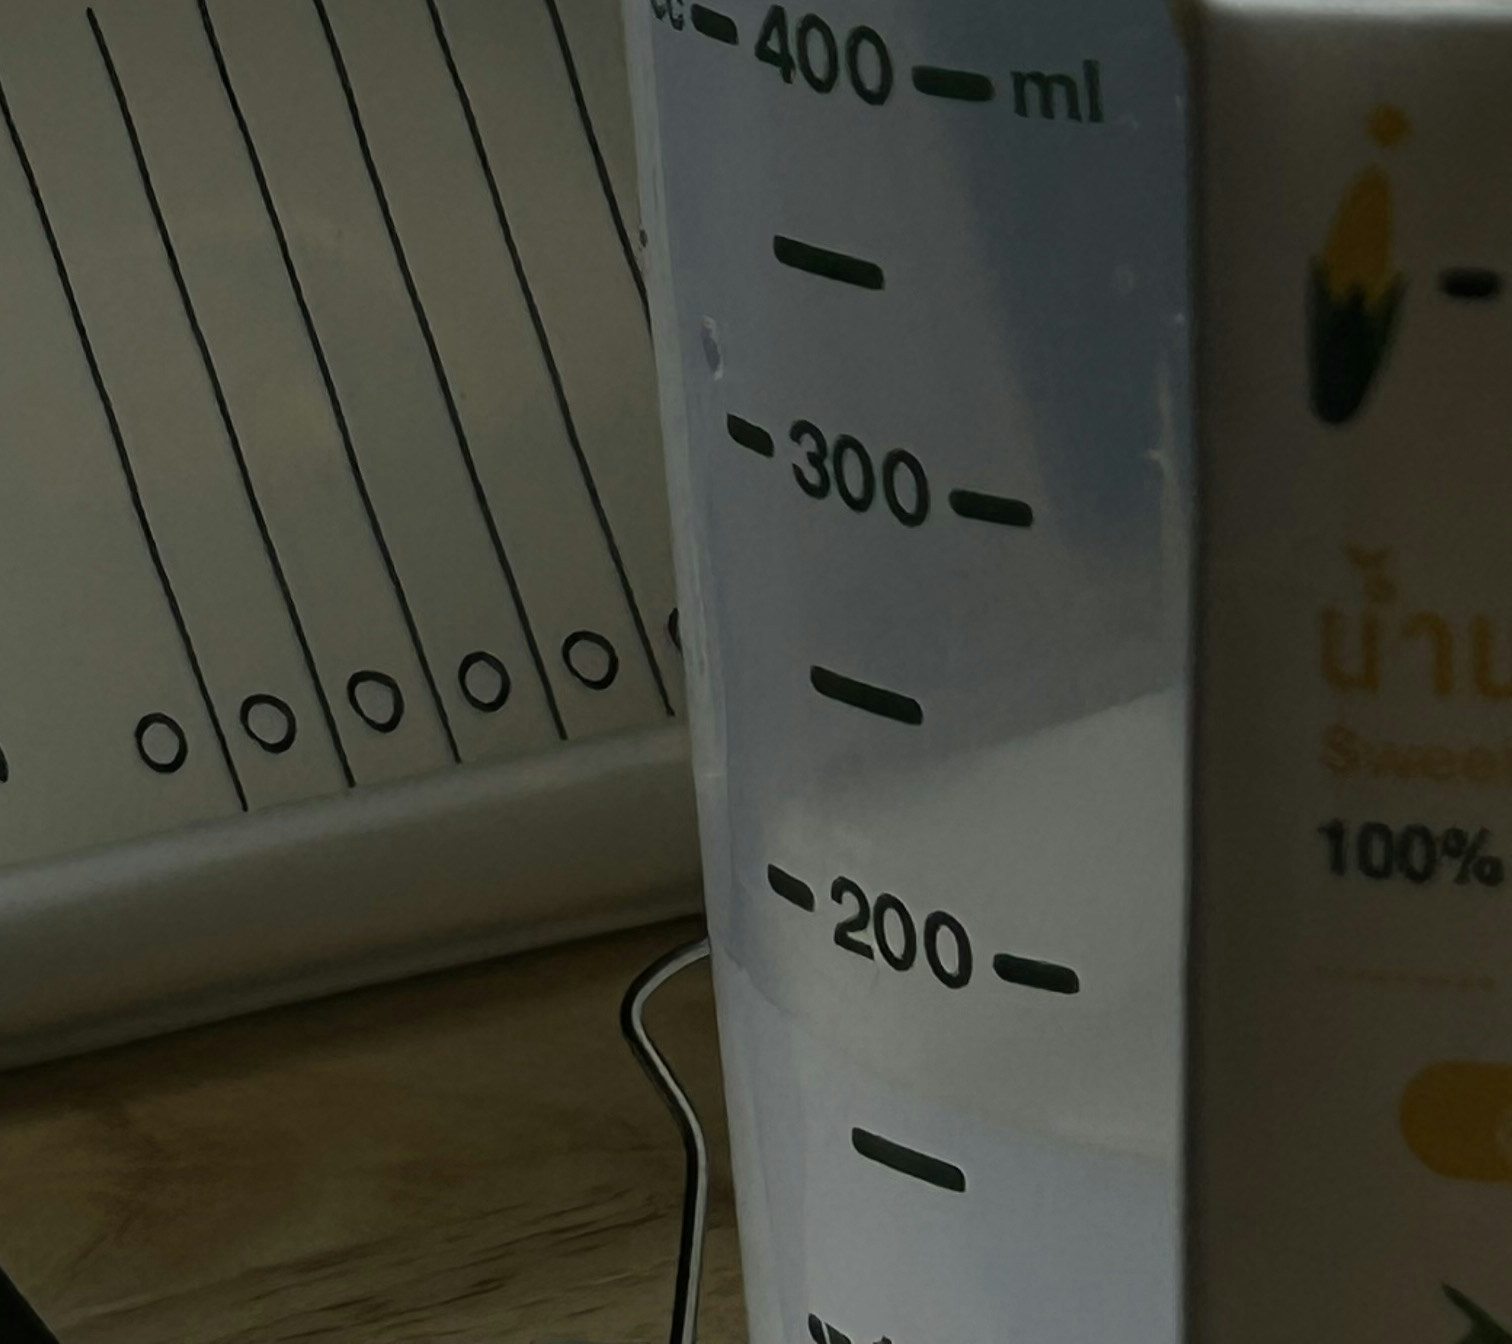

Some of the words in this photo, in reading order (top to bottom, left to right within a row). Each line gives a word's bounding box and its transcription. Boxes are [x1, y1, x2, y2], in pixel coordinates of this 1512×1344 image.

[754, 4, 894, 106] 400
[1010, 58, 1104, 123] ml
[789, 419, 930, 528] 300
[1317, 816, 1506, 888] 100%
[830, 875, 974, 990] 200
